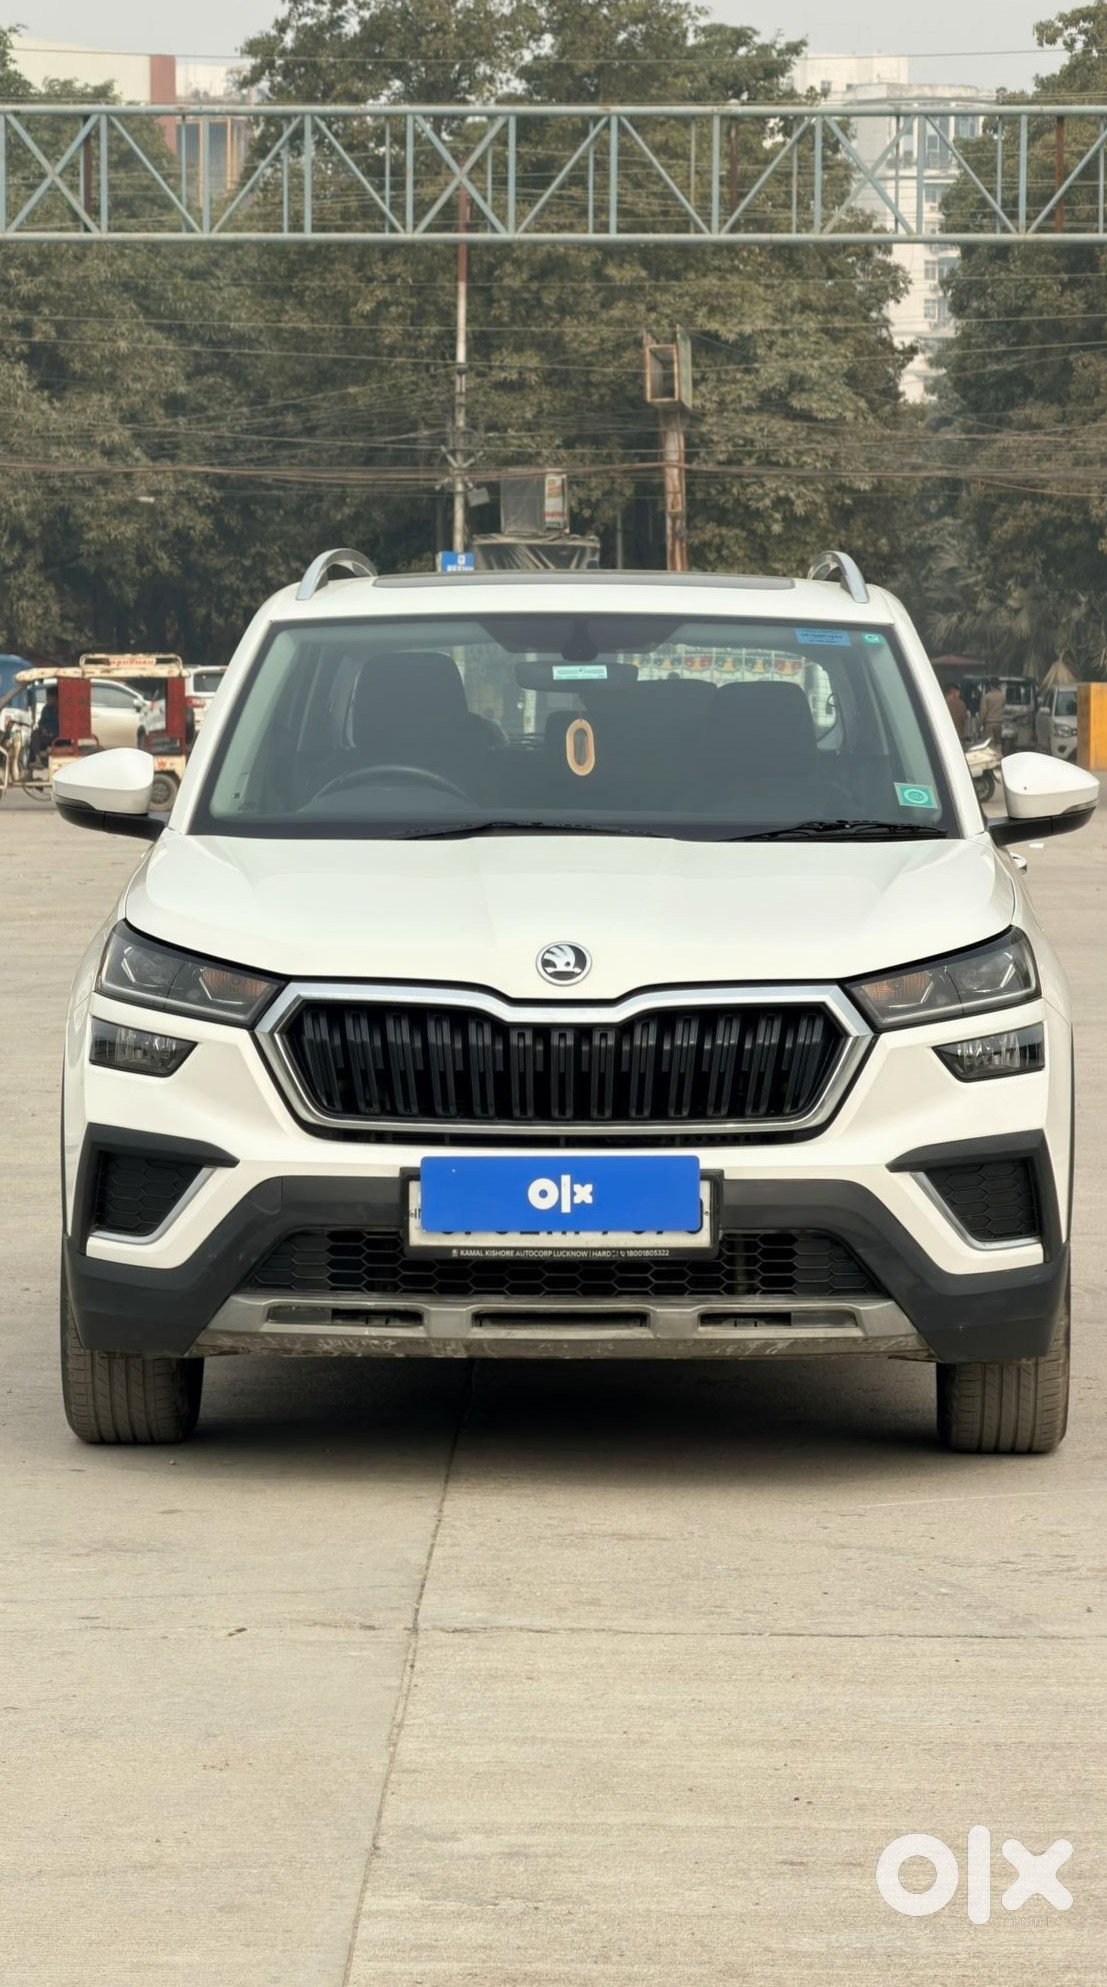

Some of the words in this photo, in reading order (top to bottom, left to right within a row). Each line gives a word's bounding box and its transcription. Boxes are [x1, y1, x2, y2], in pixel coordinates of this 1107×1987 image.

[460, 1249, 484, 1257] KAMAL
[485, 1249, 514, 1257] KISHORE
[515, 1249, 552, 1257] AUTOCORP
[553, 1250, 588, 1258] LUCKNOW
[626, 1249, 670, 1257] 18001805322
